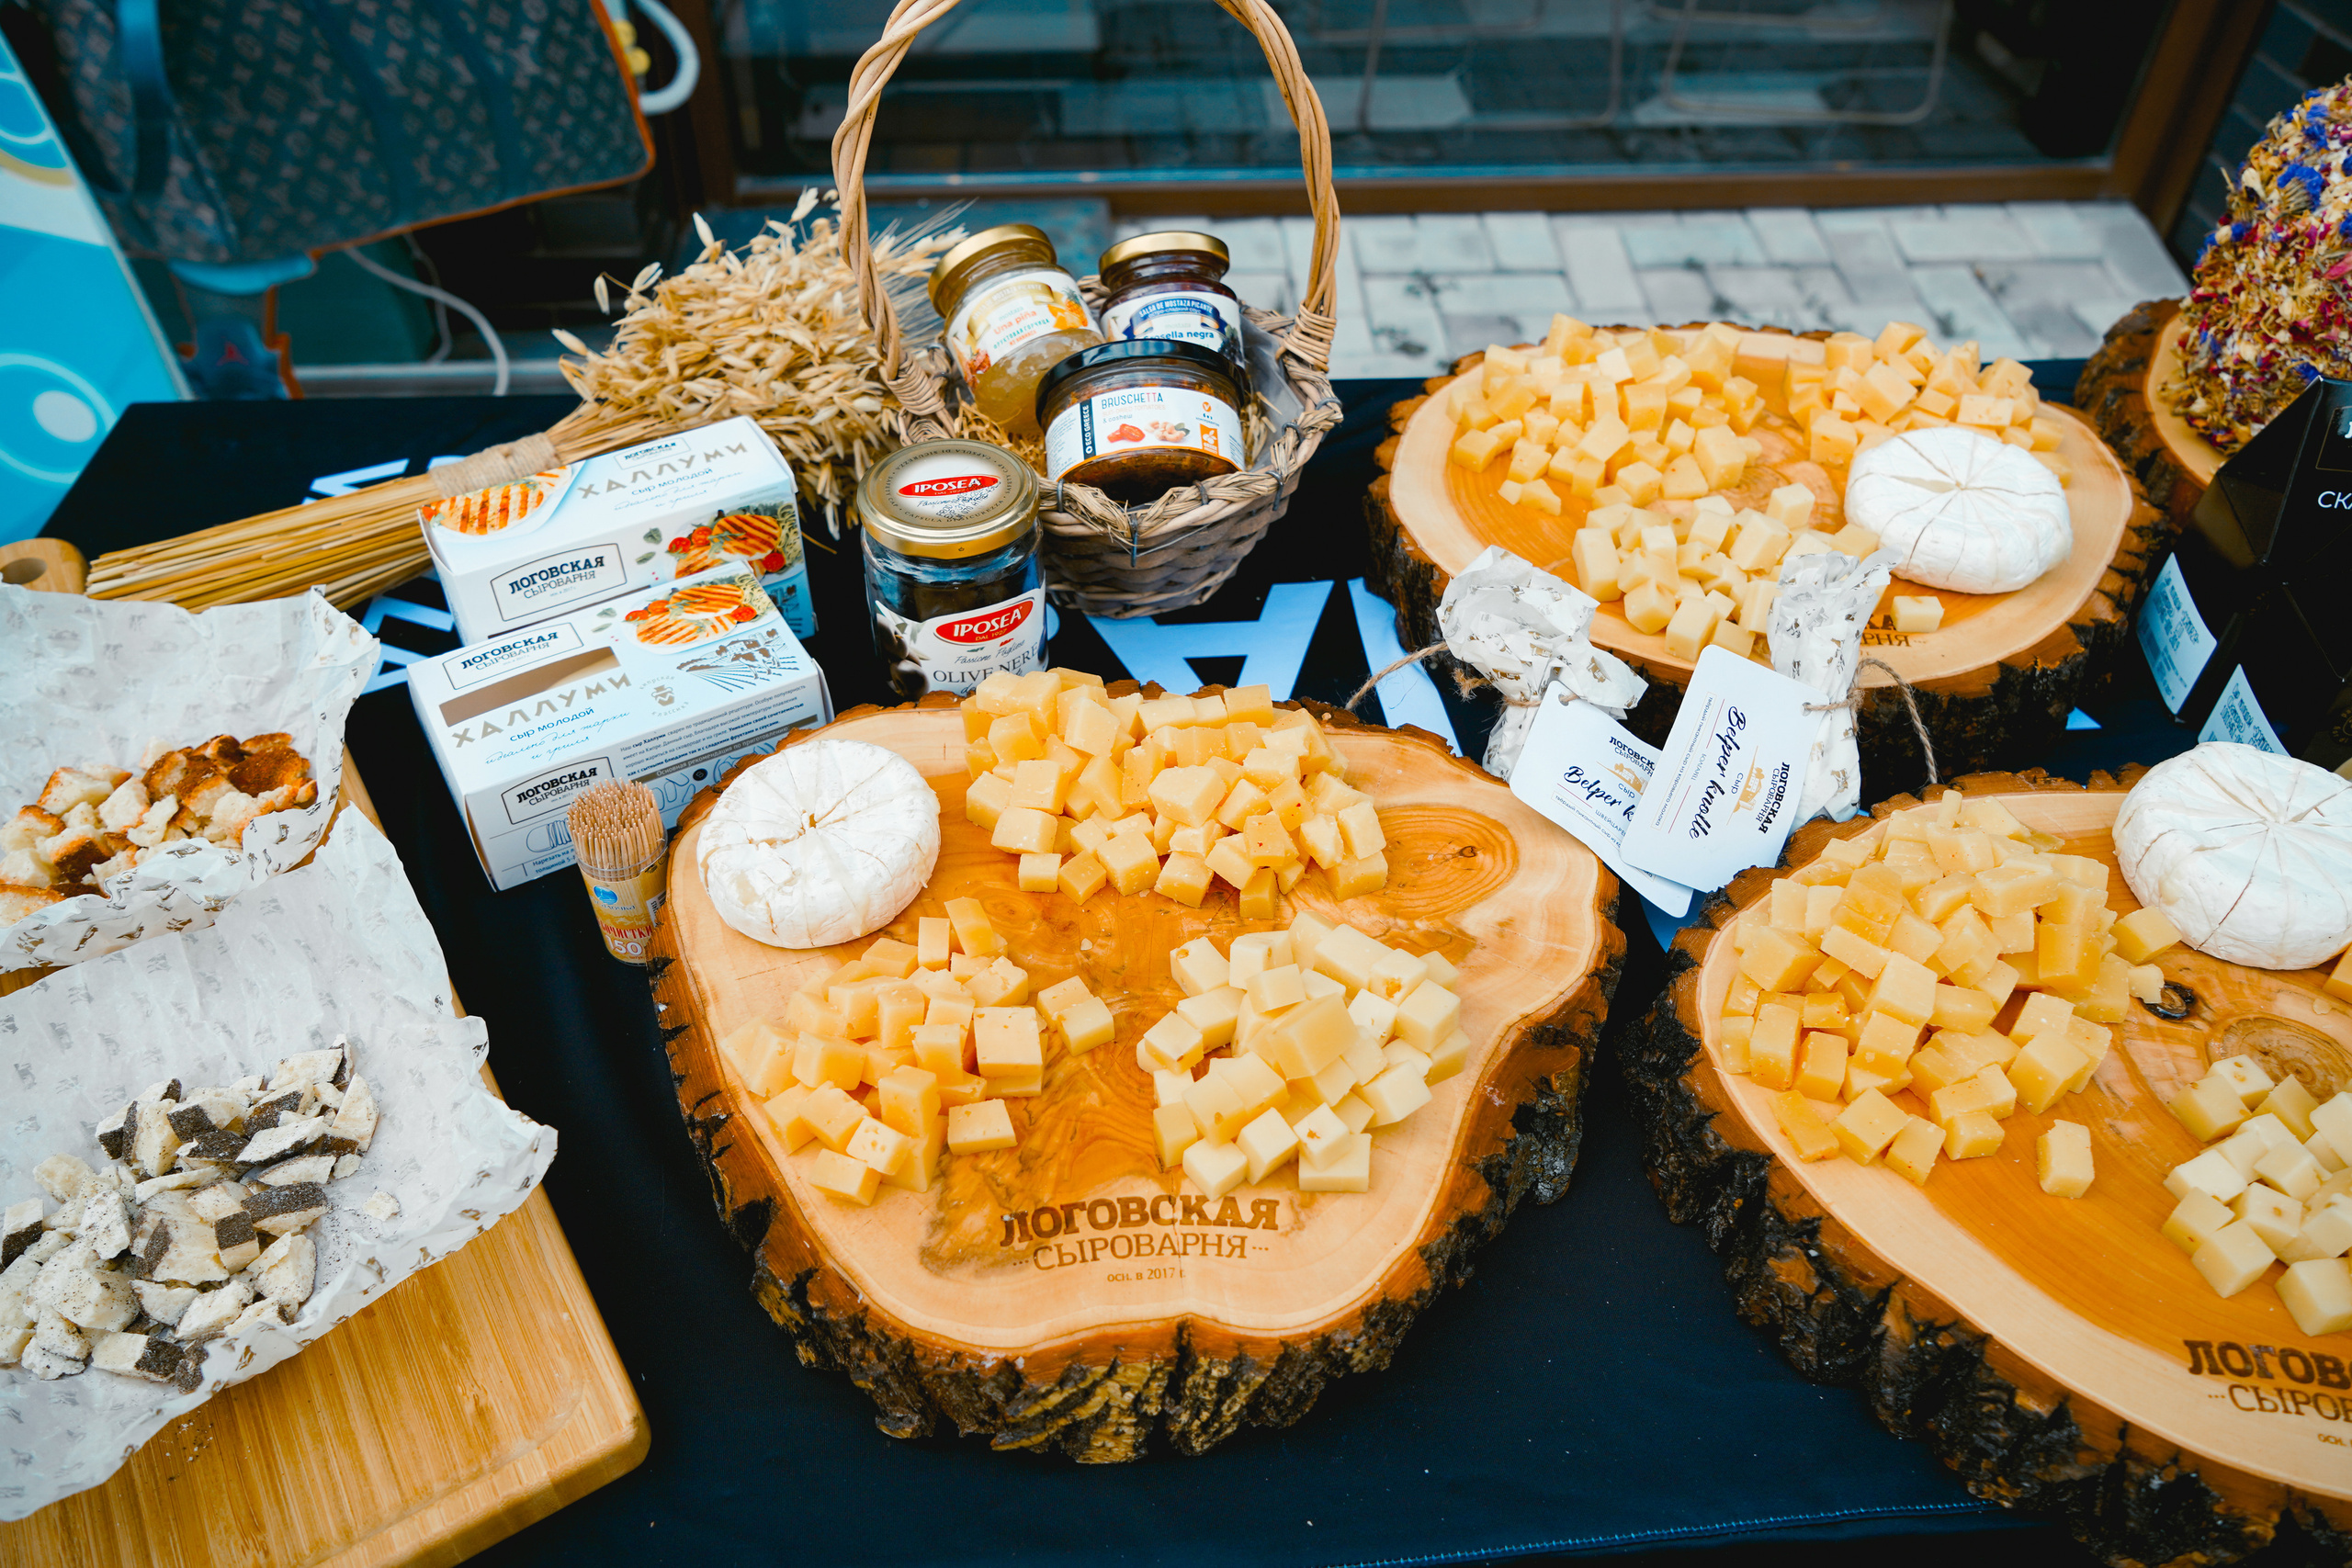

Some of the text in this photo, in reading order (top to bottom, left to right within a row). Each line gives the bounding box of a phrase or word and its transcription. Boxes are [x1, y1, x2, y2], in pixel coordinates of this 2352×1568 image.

[993, 310, 1037, 334] Una piña
[1139, 299, 1213, 318] SALSA DE MOSTAZA PICANTE
[1187, 332, 1215, 340] negra
[1102, 392, 1163, 410] BRUSCHETTA
[624, 442, 676, 460] ЛОГОВСКАЯ
[1085, 432, 1093, 446] ECO
[895, 449, 936, 470] SICUREZZA
[955, 448, 991, 460] CAPSULA
[577, 442, 748, 499] ХАЛЛУМИ
[631, 468, 713, 496] сыр молодой
[914, 478, 981, 493] IPOSEA
[904, 511, 942, 523] CAPSULA
[509, 556, 605, 594] ЛОГОВСКАЯ
[523, 570, 595, 599] СЫРОВАРНЯ
[953, 608, 1022, 637] IPOSEA
[991, 628, 1007, 637] 1927
[461, 632, 559, 670] ЛОГОВСКАЯ
[476, 642, 550, 671] СЫРОВАРНЯ
[933, 642, 1038, 683] OLIVE NERE
[955, 653, 991, 664] Passione
[451, 672, 632, 749] ХАЛЛУМИ
[643, 734, 666, 744] Халлуми
[667, 728, 684, 736] сварен
[755, 695, 773, 705] Особую
[774, 685, 806, 699] популярность
[1702, 697, 1713, 721] твёрдый
[484, 739, 547, 764] идеально
[581, 711, 630, 734] жарки
[510, 707, 595, 742] сыр молодой
[623, 752, 639, 761] имеет
[663, 737, 683, 747] Данный
[694, 724, 719, 735] благодаря
[720, 716, 741, 727] высокой
[741, 706, 772, 719] температуры
[773, 696, 797, 708] плавления
[625, 759, 644, 768] хорошо
[645, 750, 668, 761] жариться
[675, 738, 701, 750] сковороде
[729, 721, 752, 732] Уникален
[752, 715, 767, 724] своей
[767, 703, 804, 718] сочетаемостью
[1689, 721, 1703, 752] пикантный
[548, 736, 590, 761] гриля
[640, 761, 663, 772] сытными
[664, 752, 688, 763] блюдами
[705, 739, 729, 749] сладкими
[730, 729, 754, 741] фруктами
[656, 762, 687, 776] Основная
[687, 746, 733, 767] рекомендация
[1609, 736, 1656, 771] ЛОГОВСК
[1614, 747, 1654, 777] СЫРОВАРН
[516, 767, 597, 804] ЛОГОВСКАЯ
[1563, 765, 1622, 807] Belper
[1689, 705, 1747, 840] Belper knolle
[1731, 773, 1744, 795] сыр
[528, 779, 590, 806] СЫРОВАРНЯ
[1618, 783, 1635, 799] сыр
[1666, 773, 1681, 803] коровьего
[1756, 768, 1781, 822] СЫРОВАРНЯ
[1758, 761, 1790, 833] ЛОГОВСКАЯ
[1576, 810, 1600, 829] пикантный
[1600, 829, 1611, 838] сыр
[1656, 803, 1668, 826] молока
[533, 854, 561, 866] Нарезать
[535, 860, 566, 874] толщиной
[605, 933, 643, 956] 150
[1000, 1194, 1281, 1247] ЛОГОВСКАЯ
[1032, 1232, 1249, 1271] СЫРОВАРНЯ
[1106, 1271, 1133, 1282] осн.
[1136, 1272, 1144, 1281] в
[1147, 1268, 1175, 1280] 2017
[2183, 1339, 2352, 1390] ЛОГОВ
